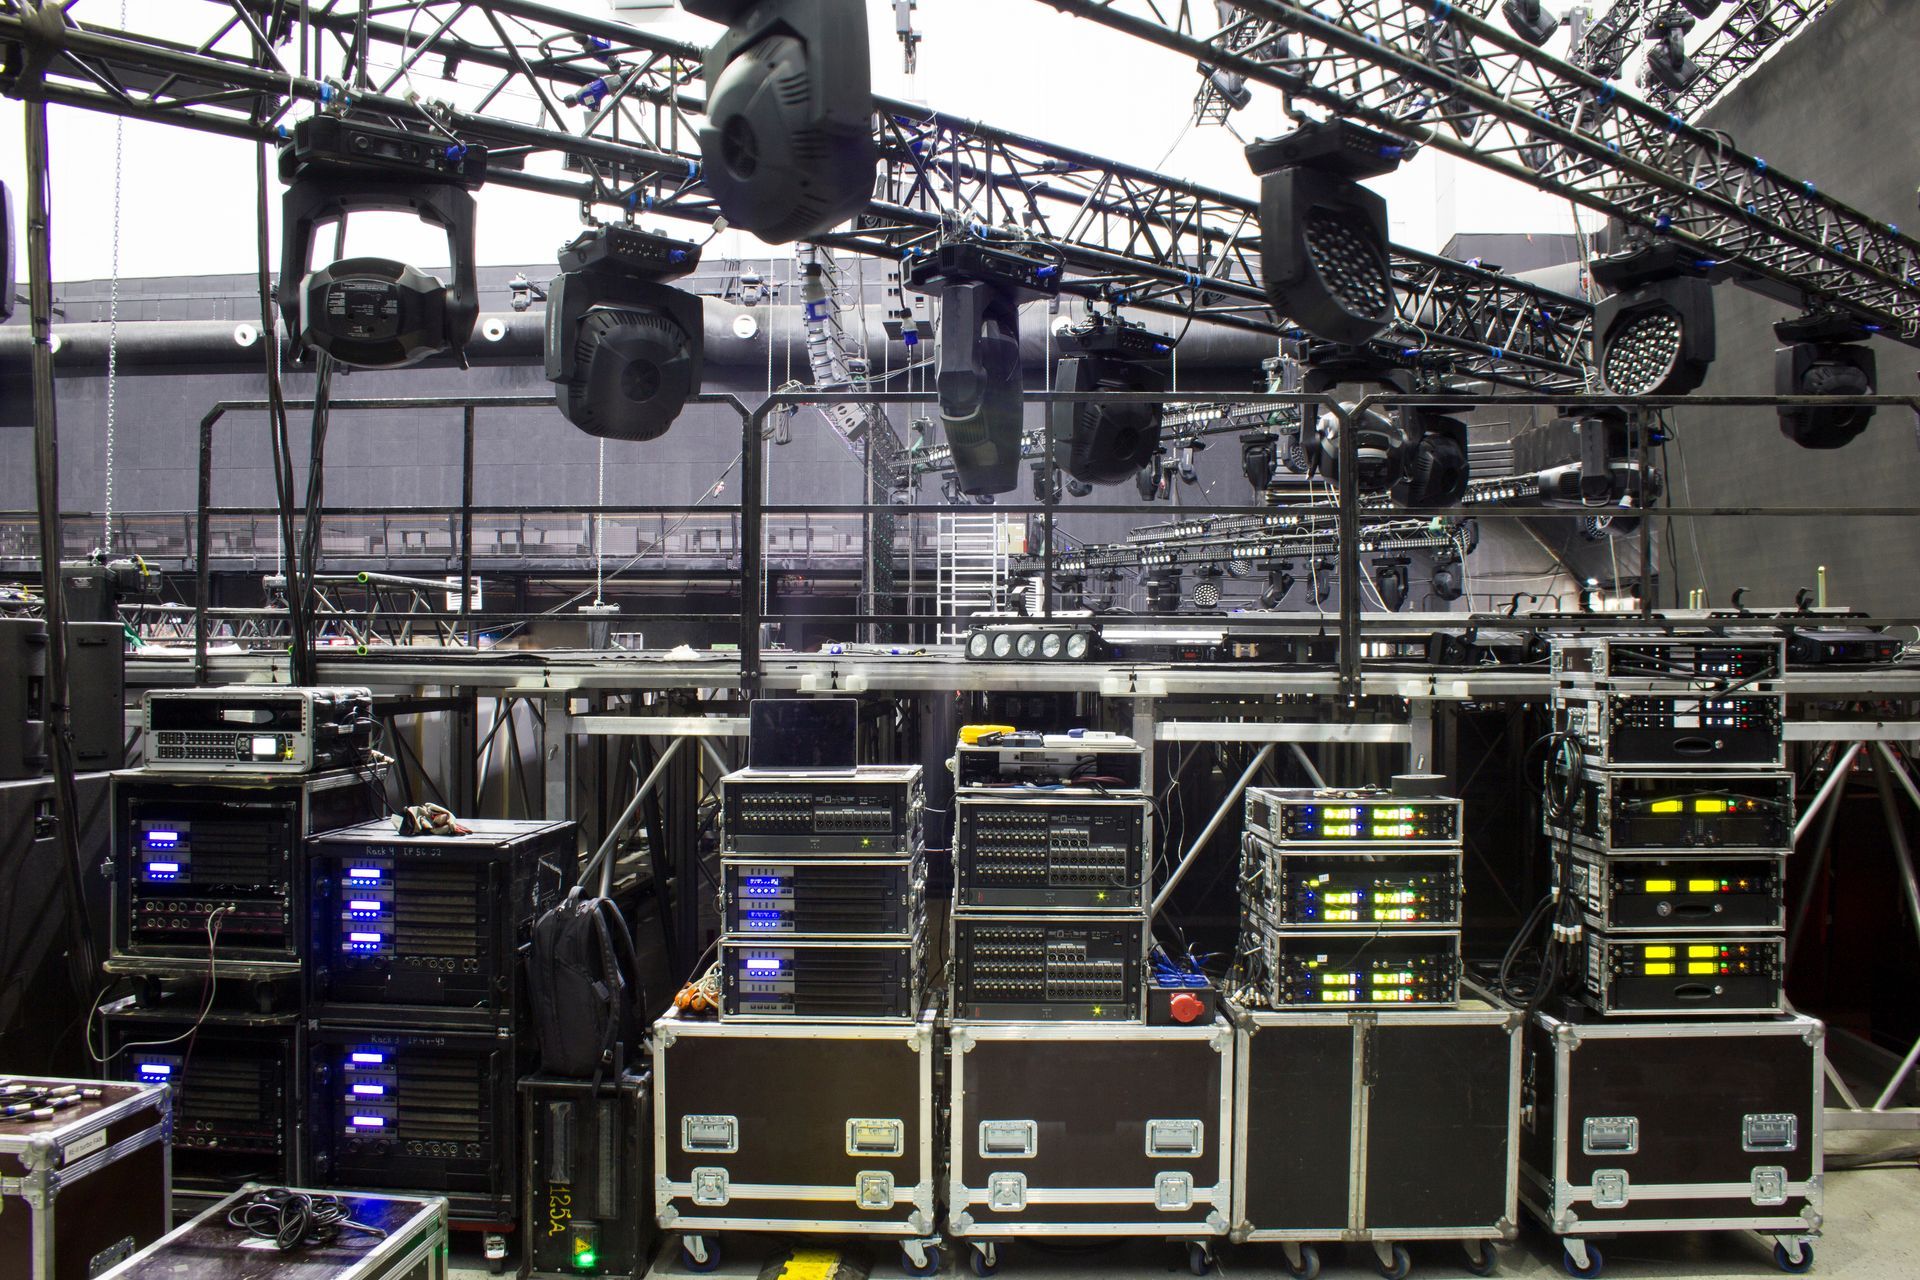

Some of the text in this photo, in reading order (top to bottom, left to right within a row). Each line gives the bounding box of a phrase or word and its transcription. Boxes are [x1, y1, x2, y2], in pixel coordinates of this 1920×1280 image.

[366, 846, 386, 856] Rack
[389, 846, 395, 856] 4
[548, 1186, 572, 1237] 125A
